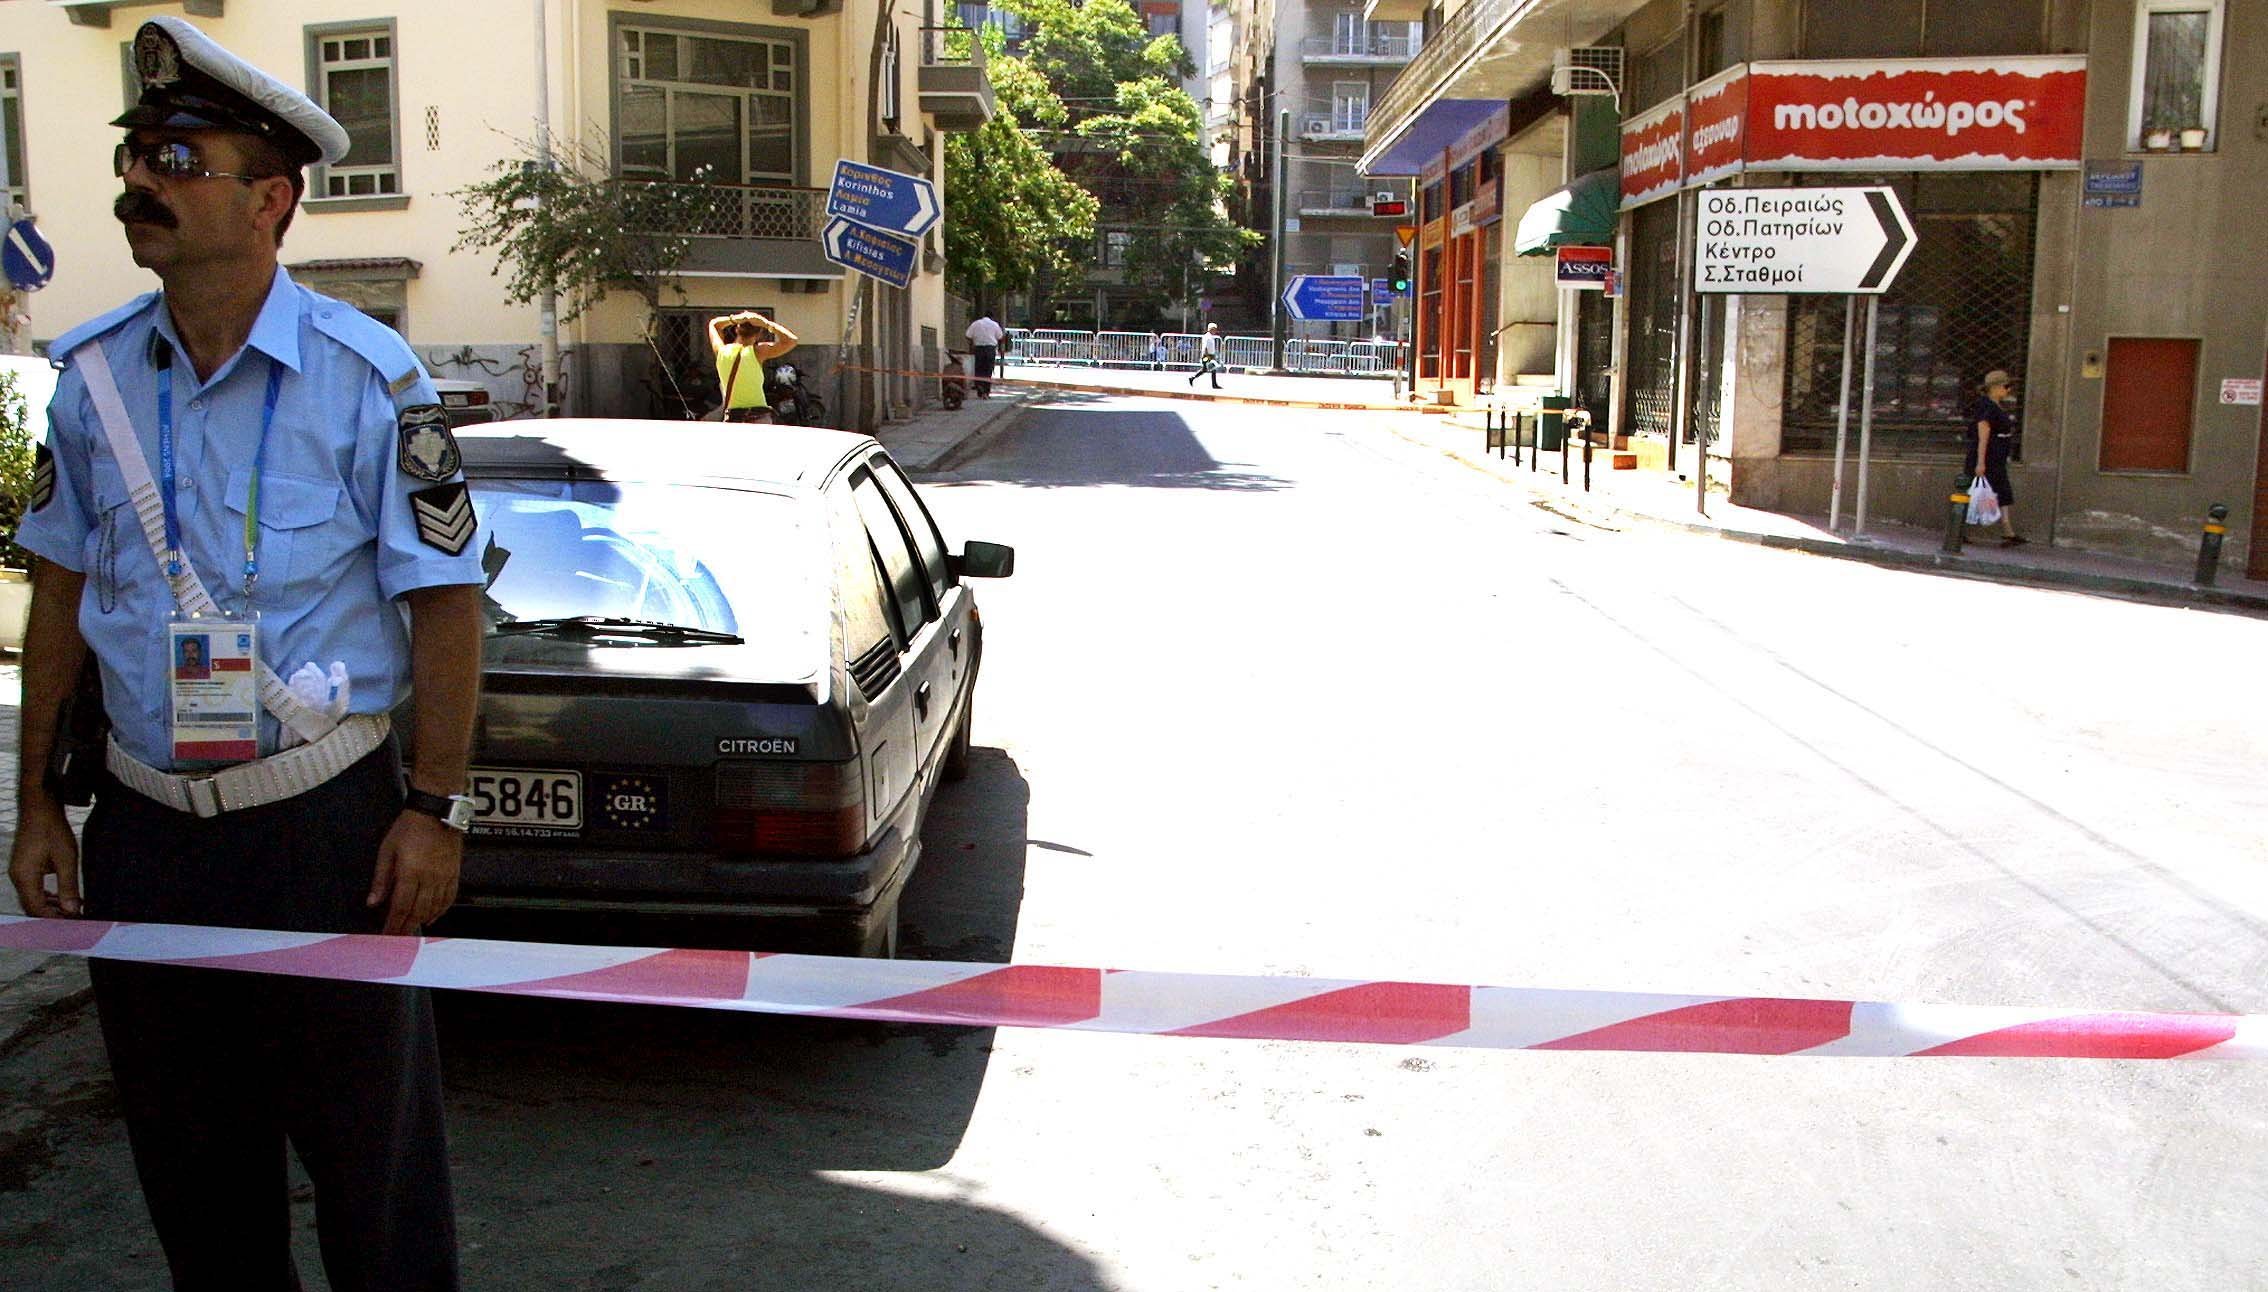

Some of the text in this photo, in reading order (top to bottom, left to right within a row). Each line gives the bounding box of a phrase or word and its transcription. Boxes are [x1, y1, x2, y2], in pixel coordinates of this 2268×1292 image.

[837, 176, 895, 200] Korinthos
[833, 200, 867, 217] Lamia
[846, 238, 885, 261] Kifisias
[1705, 242, 1776, 264] Κέντρο
[718, 738, 796, 753] CITROËN
[472, 775, 575, 820] 5846
[613, 794, 648, 812] GR
